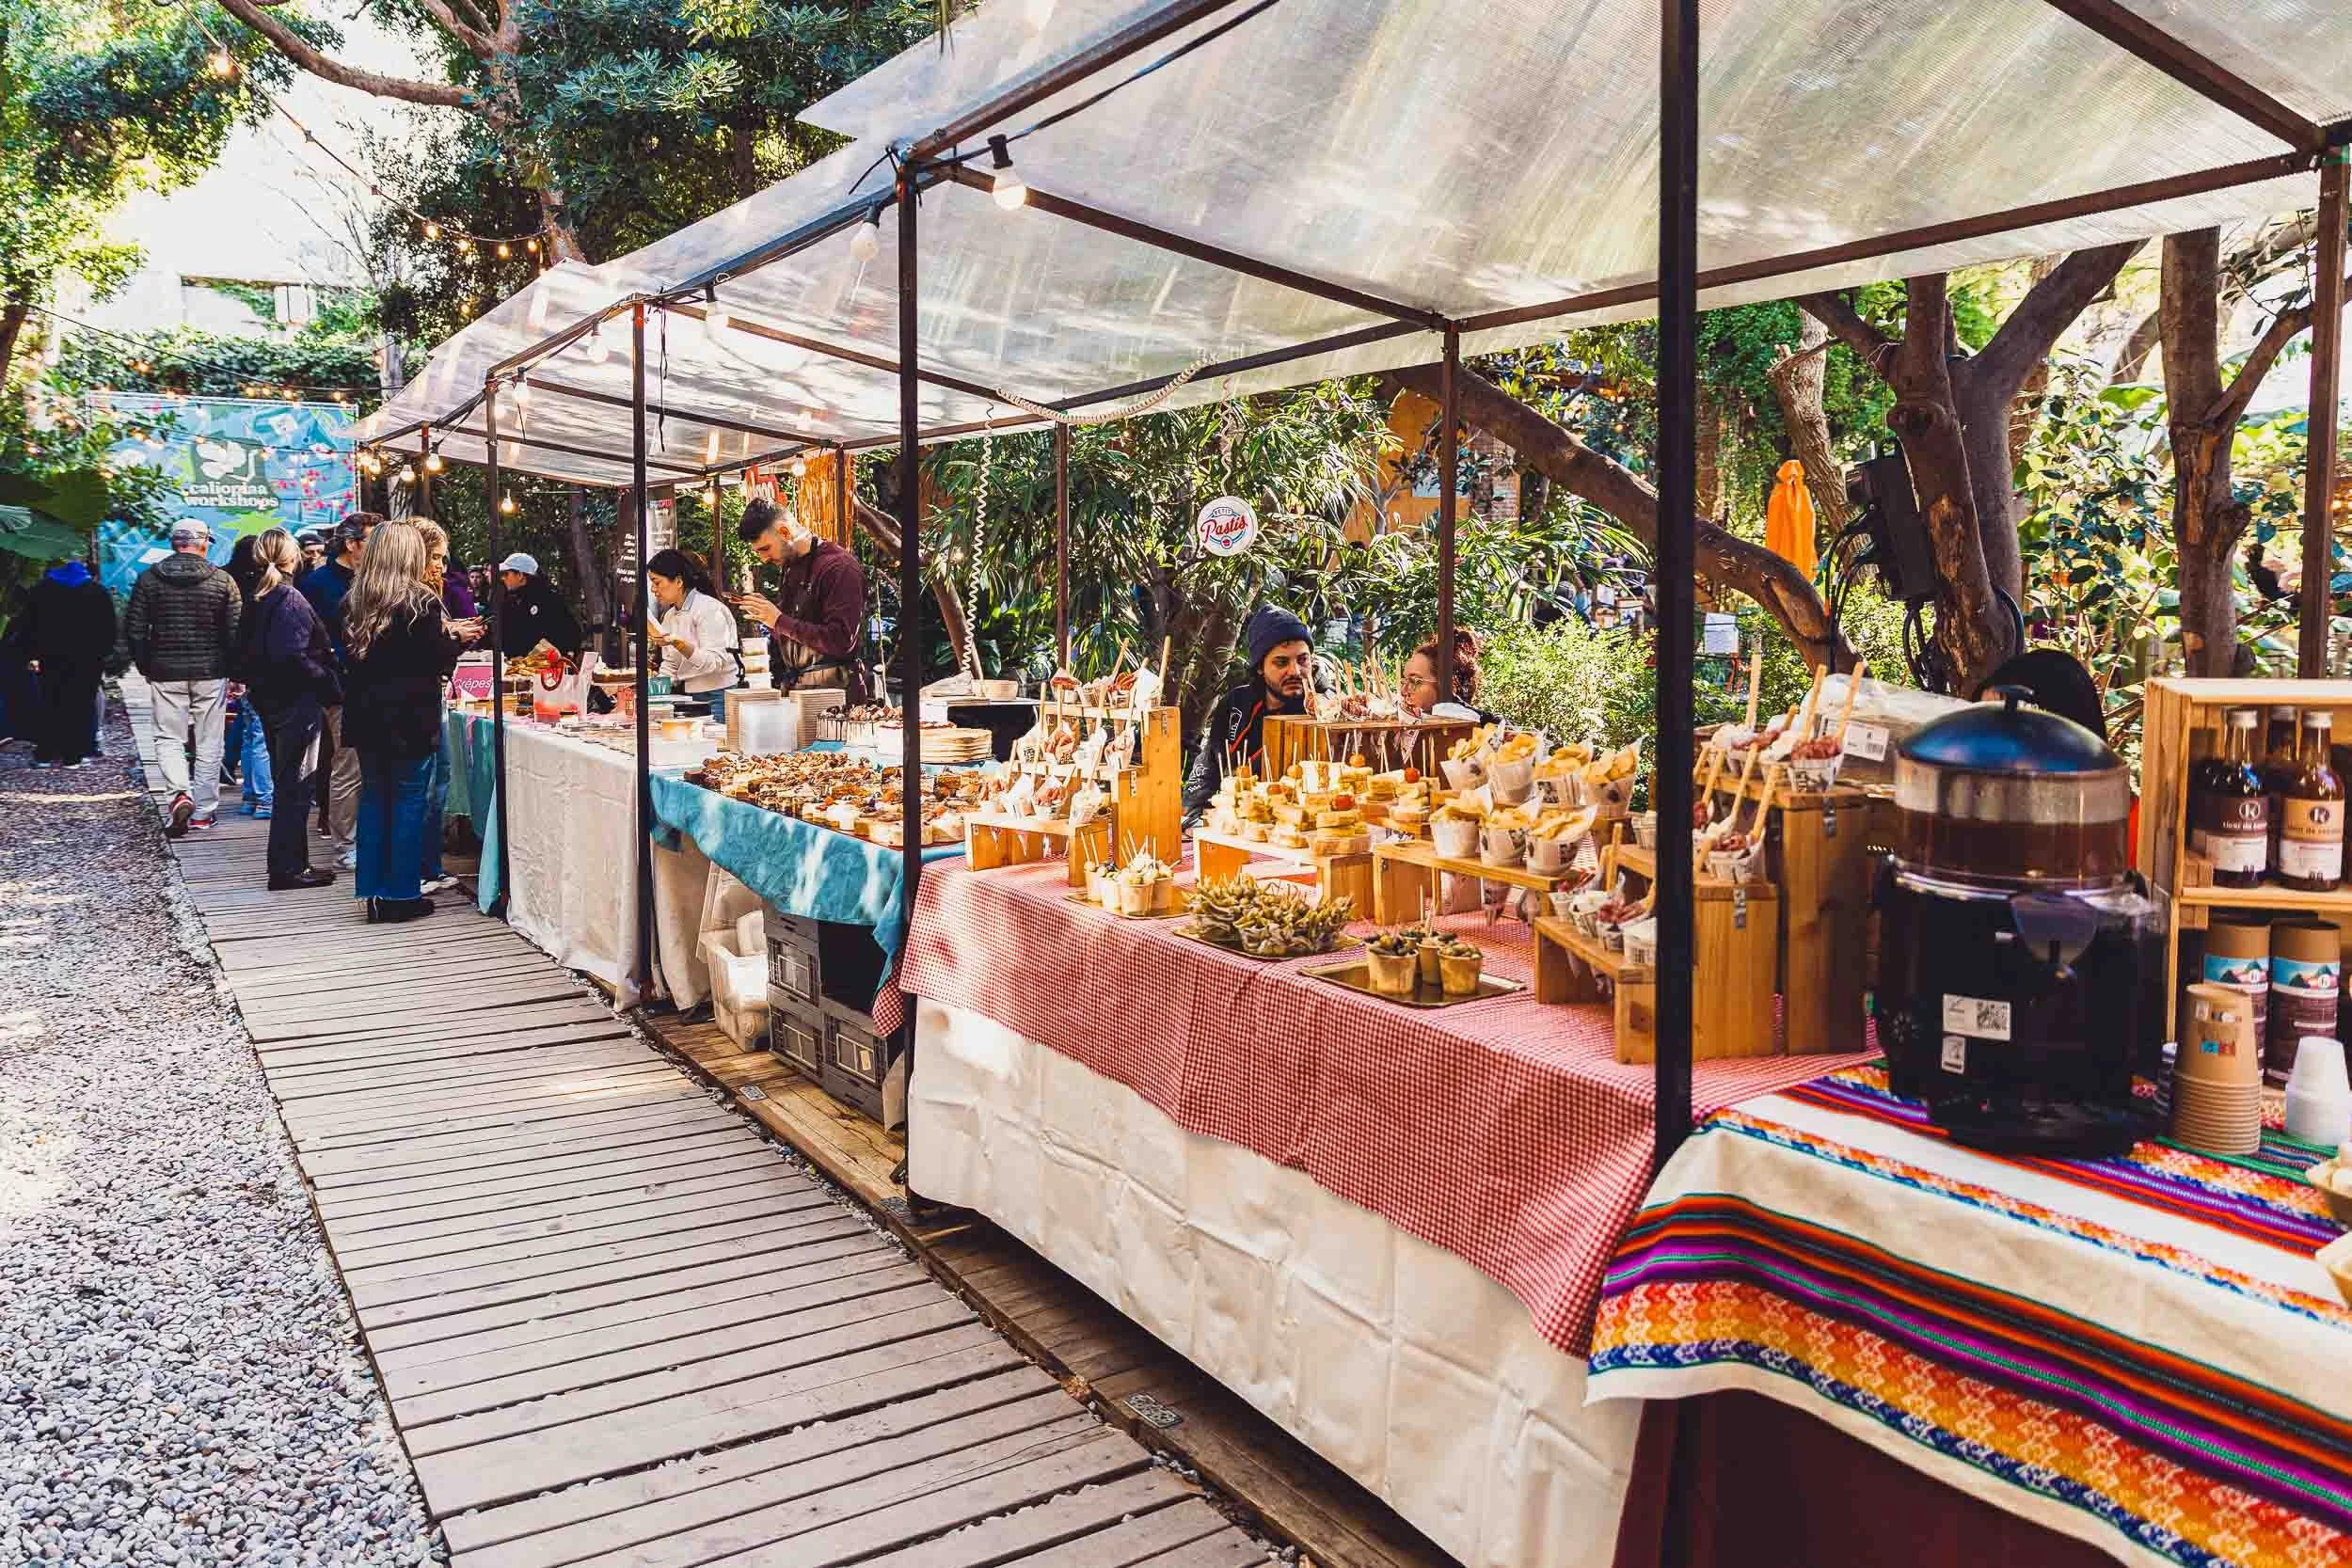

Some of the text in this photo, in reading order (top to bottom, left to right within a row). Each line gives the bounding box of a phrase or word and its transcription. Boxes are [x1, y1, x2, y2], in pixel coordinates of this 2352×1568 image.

[185, 494, 279, 511] workshops
[1200, 514, 1248, 544] Pastis
[453, 677, 492, 692] Crêpes
